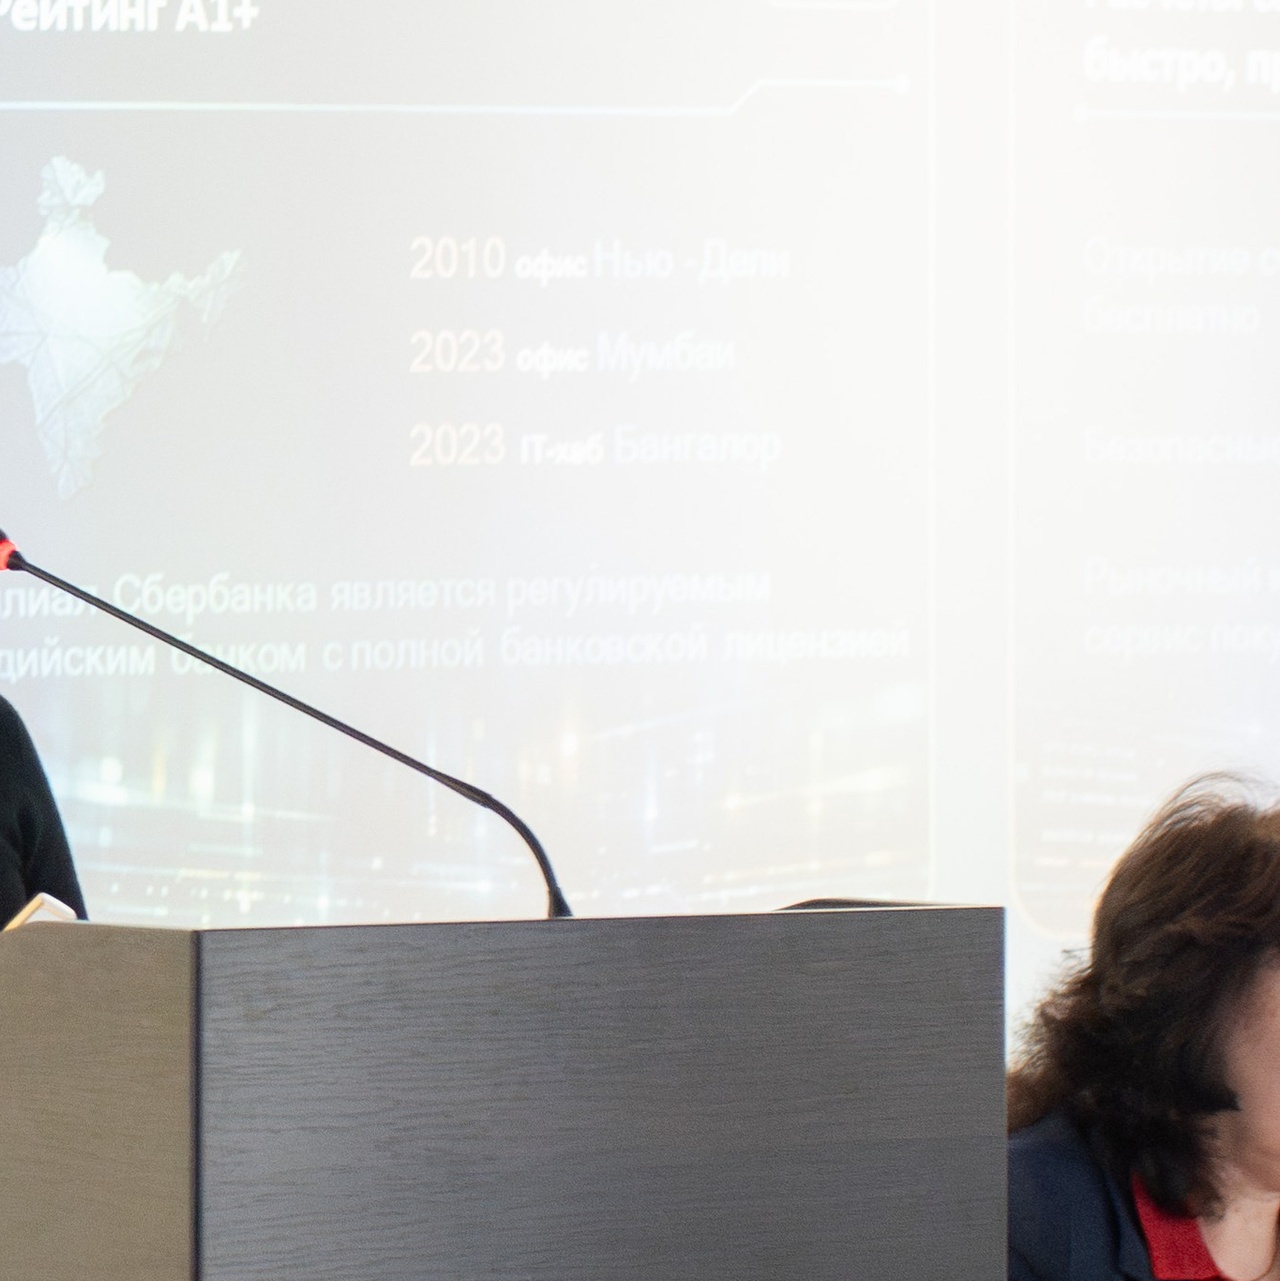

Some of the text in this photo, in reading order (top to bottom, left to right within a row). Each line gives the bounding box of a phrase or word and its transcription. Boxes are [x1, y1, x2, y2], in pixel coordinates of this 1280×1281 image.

[410, 236, 507, 279] 2010
[515, 247, 588, 287] офис
[410, 330, 507, 372] 2023
[515, 340, 589, 380] офис
[410, 423, 507, 466] 2023
[613, 423, 782, 474] Бангалор
[113, 573, 318, 626] Сбербанка
[330, 577, 496, 612] является
[507, 573, 772, 617] регулируемым
[323, 642, 344, 672] с
[350, 630, 485, 669] полной
[500, 623, 708, 666] банковской
